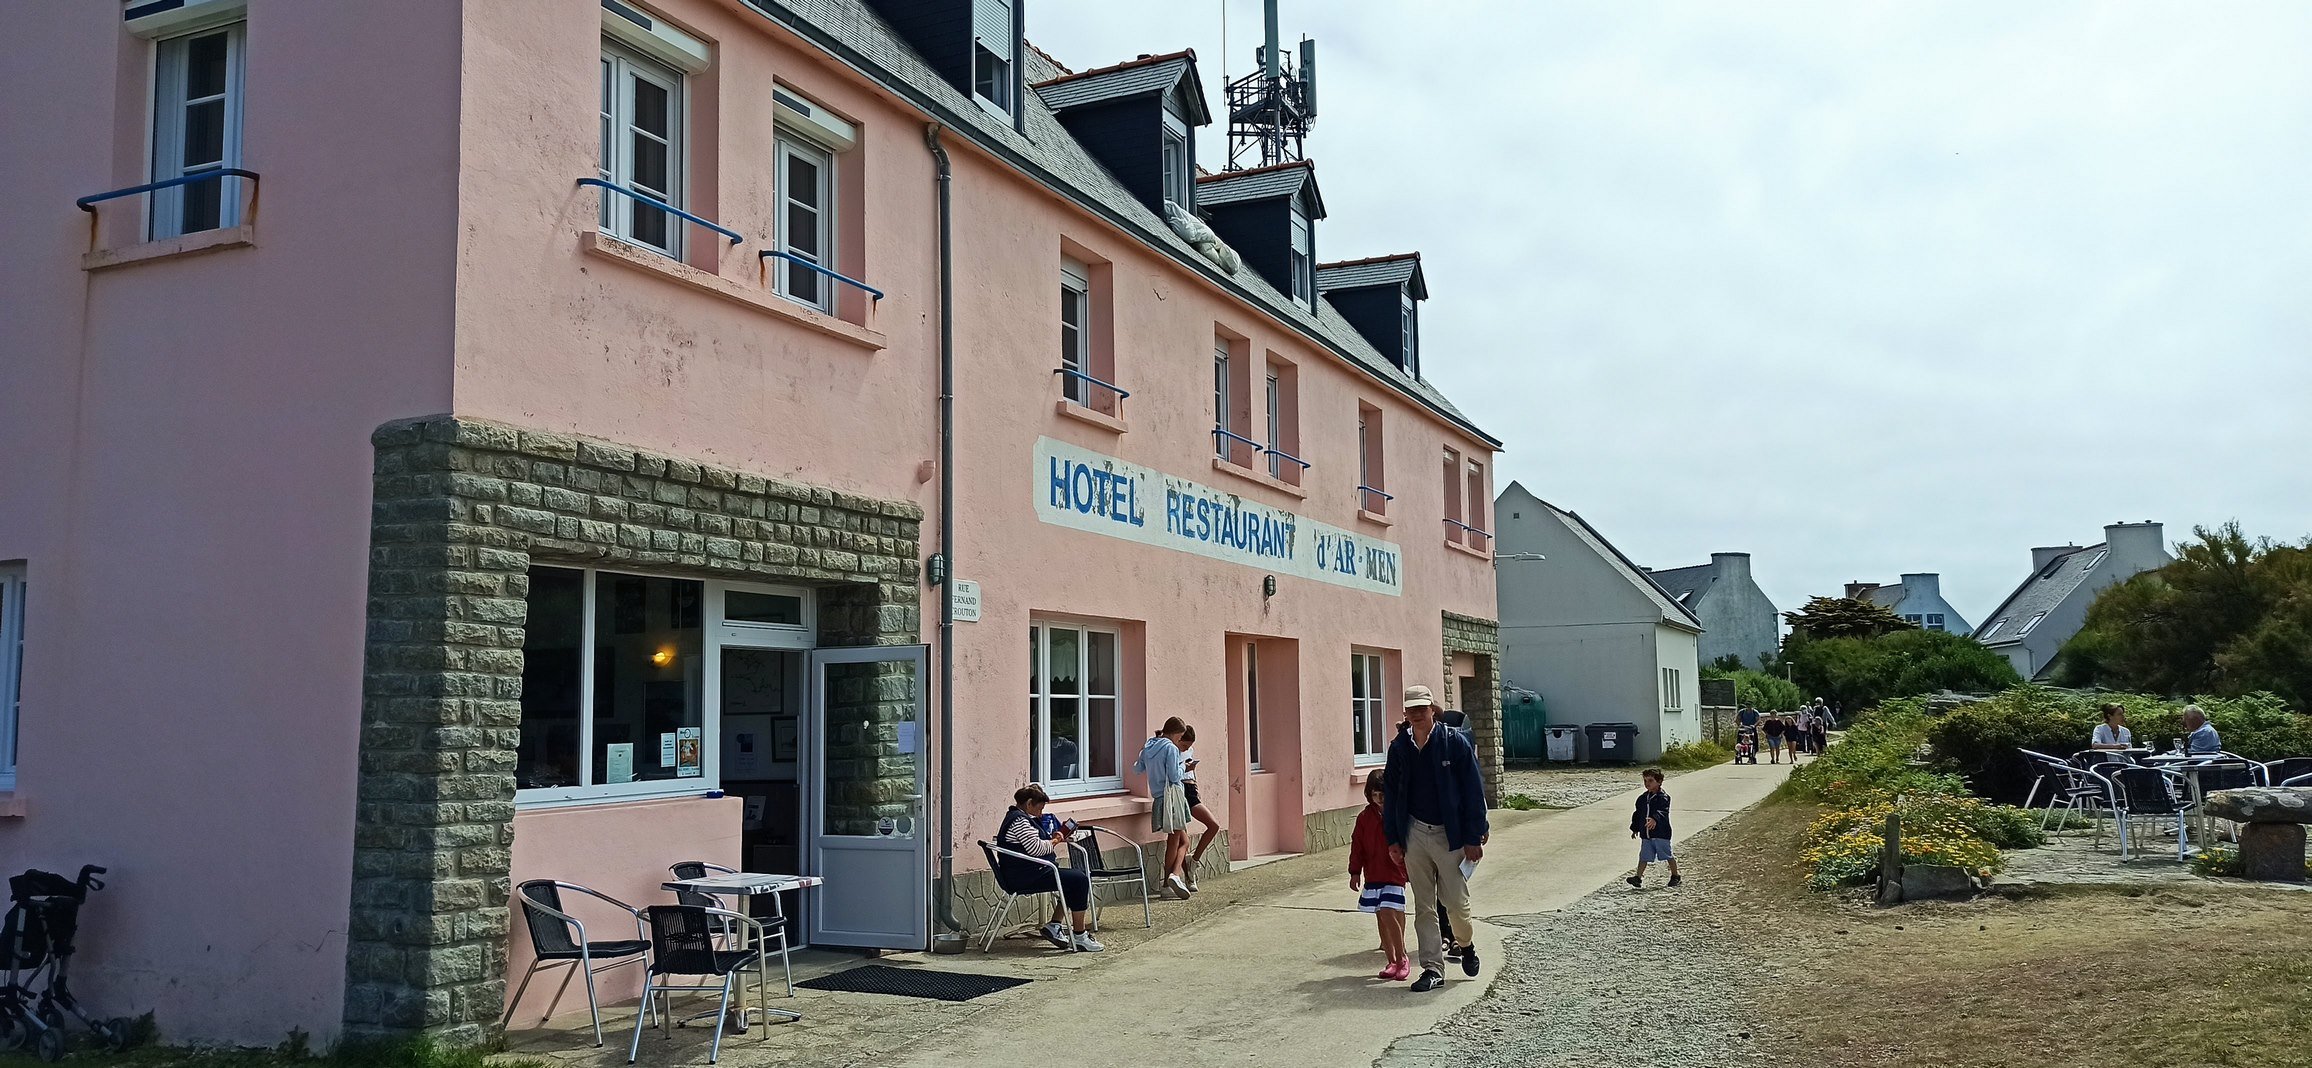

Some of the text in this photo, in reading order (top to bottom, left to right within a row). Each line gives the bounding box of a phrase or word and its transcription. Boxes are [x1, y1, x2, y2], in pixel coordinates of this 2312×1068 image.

[1050, 455, 1144, 527] HOTEL
[1166, 487, 1296, 561] RESTAURANT
[958, 583, 970, 593] RUE
